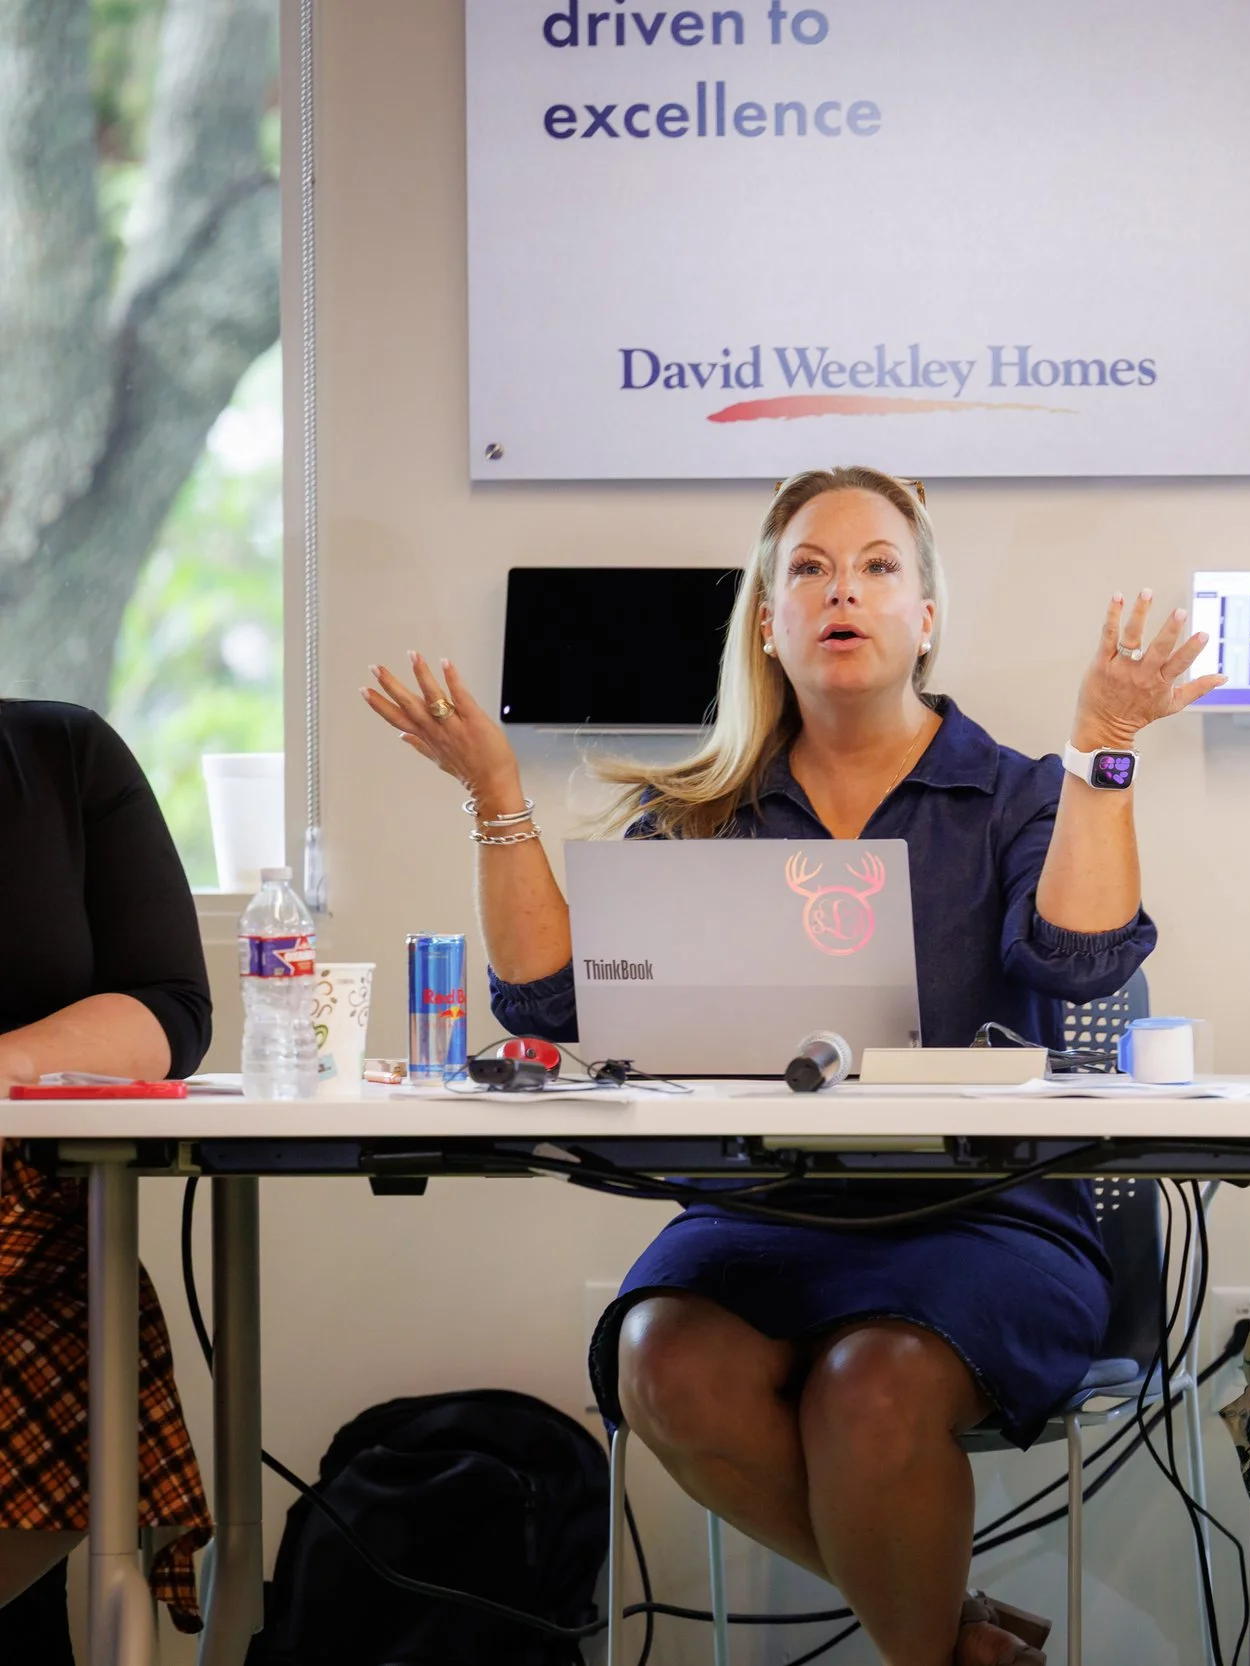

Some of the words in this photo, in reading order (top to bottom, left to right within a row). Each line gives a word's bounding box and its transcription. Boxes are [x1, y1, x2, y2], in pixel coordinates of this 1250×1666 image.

[543, 0, 745, 48] driven
[767, 0, 829, 46] to
[544, 80, 882, 139] excellence
[618, 344, 764, 390] David
[772, 343, 977, 398] Weekley
[987, 344, 1157, 387] Homes
[583, 959, 653, 980] ThinkBook
[423, 988, 455, 1004] Red
